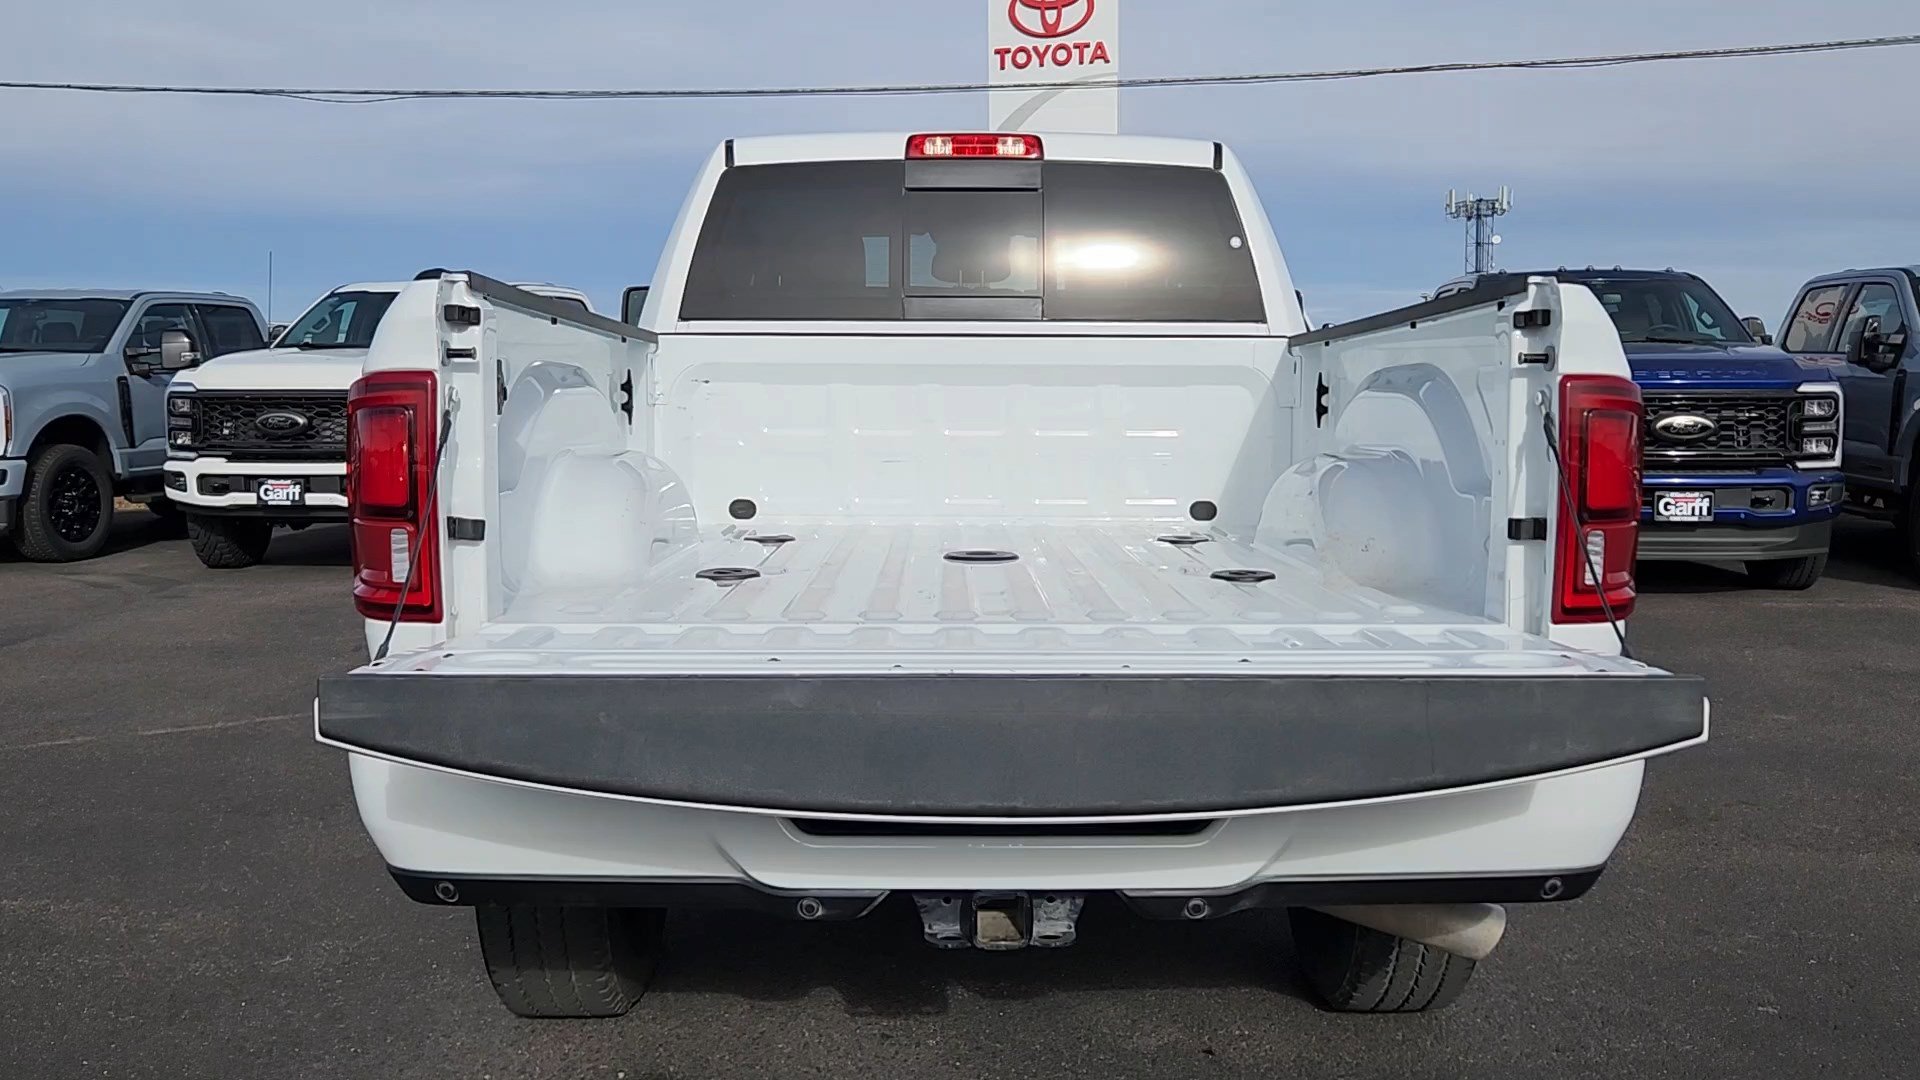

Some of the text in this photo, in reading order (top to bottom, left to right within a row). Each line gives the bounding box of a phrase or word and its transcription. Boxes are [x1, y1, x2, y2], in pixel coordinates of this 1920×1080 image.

[994, 41, 1110, 70] TOYOTA
[264, 417, 292, 429] Ford
[259, 484, 301, 500] Garff
[1659, 497, 1710, 515] Garff
